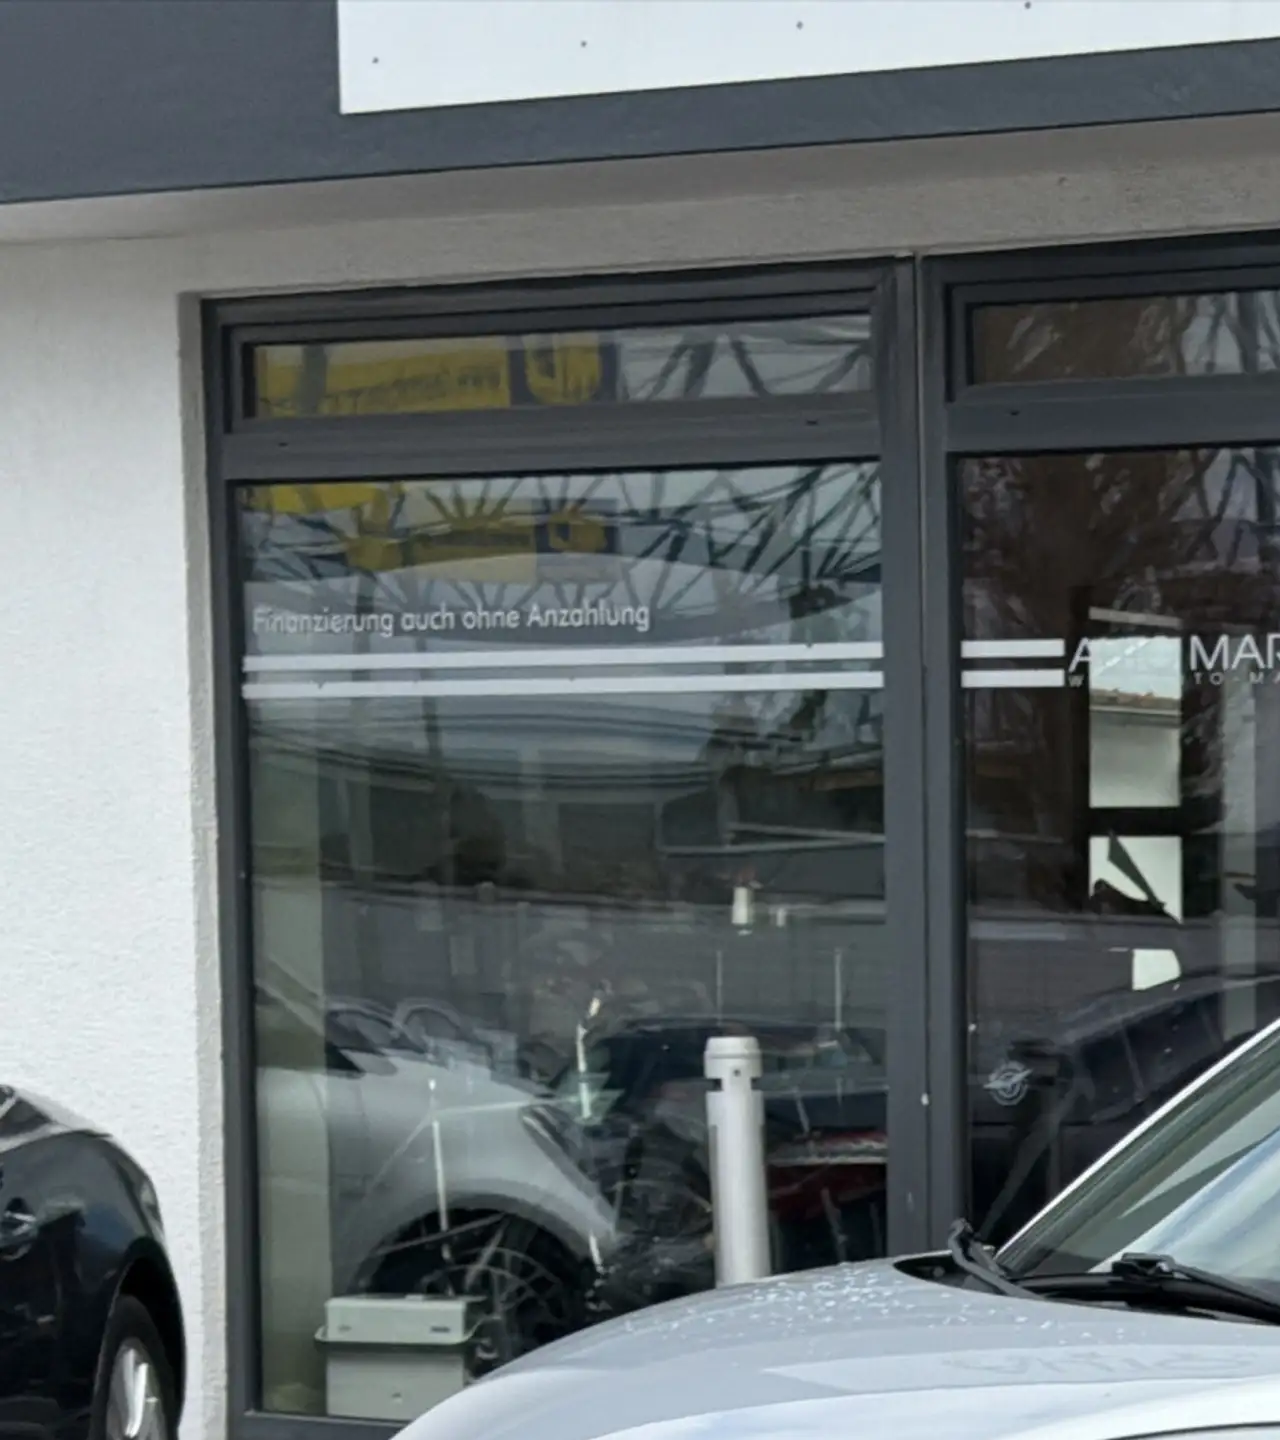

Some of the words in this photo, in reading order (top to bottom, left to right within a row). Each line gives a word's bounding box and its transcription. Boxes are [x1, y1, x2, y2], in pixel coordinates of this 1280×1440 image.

[252, 606, 394, 638] Finanzierung
[401, 604, 456, 632] auch
[462, 602, 520, 630] ohne
[526, 602, 650, 633] Anzahlung
